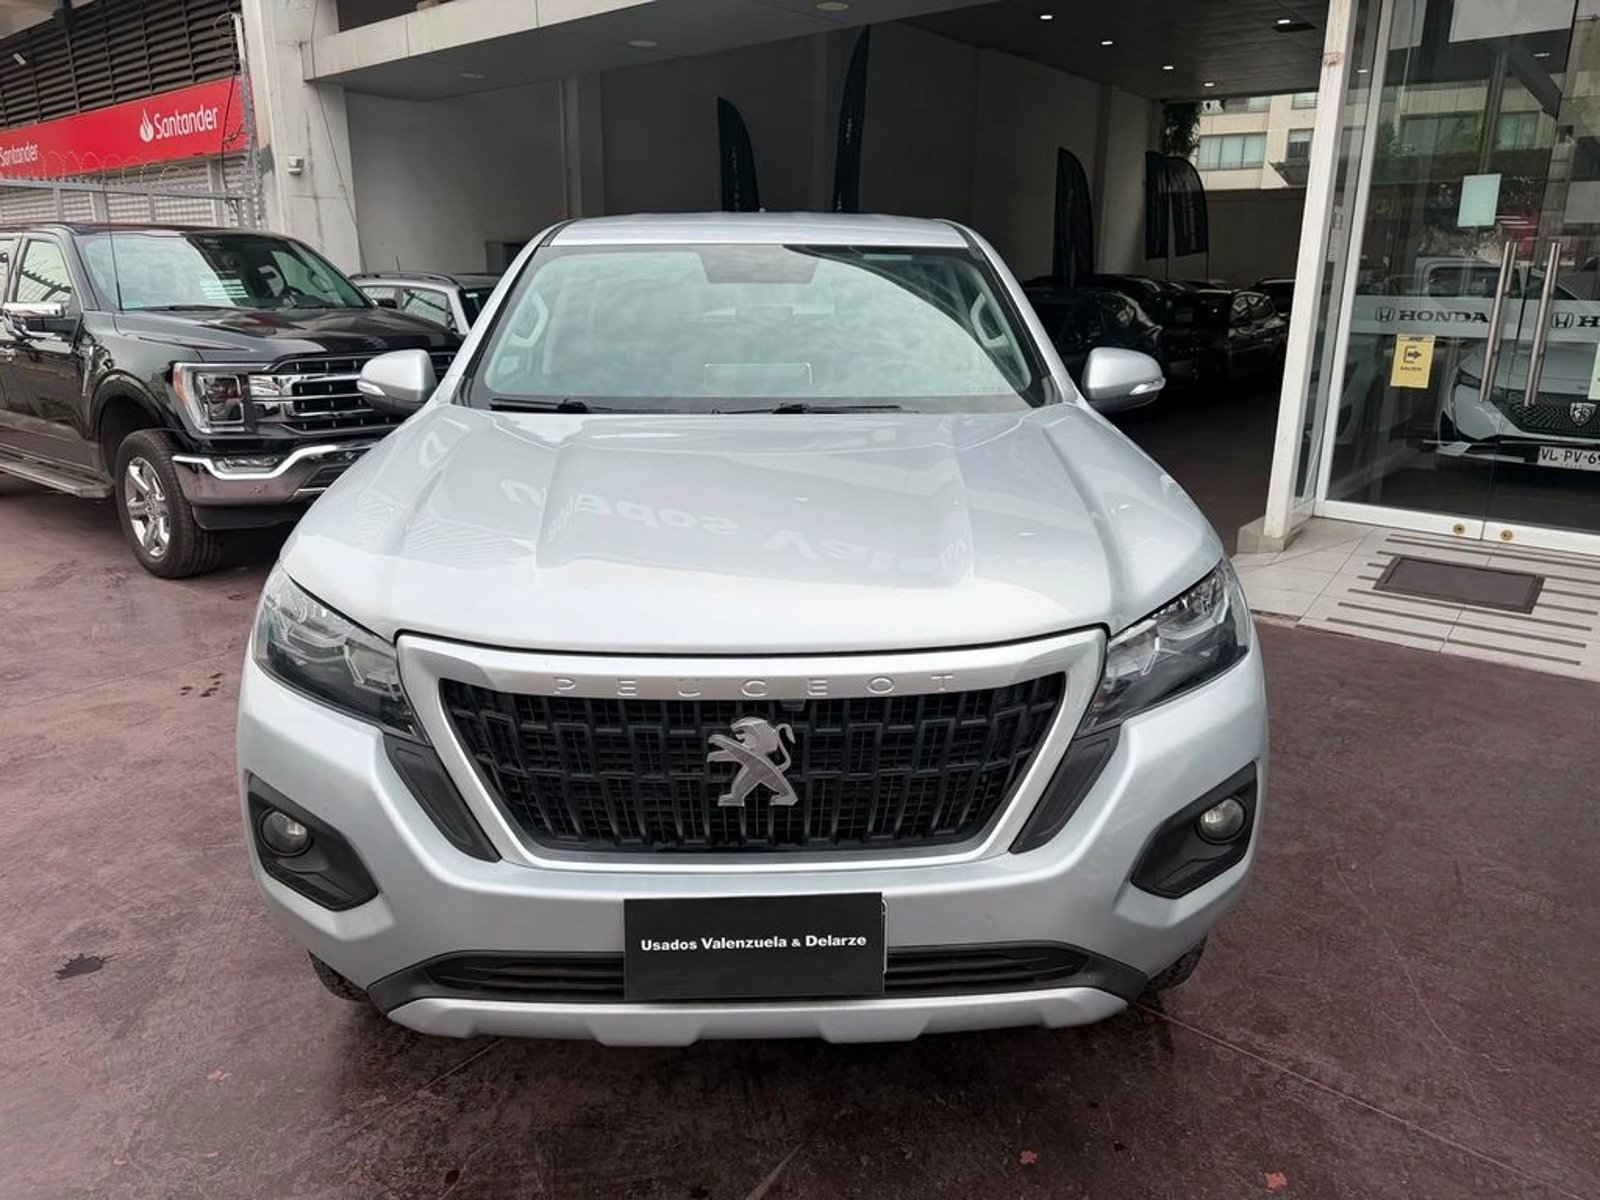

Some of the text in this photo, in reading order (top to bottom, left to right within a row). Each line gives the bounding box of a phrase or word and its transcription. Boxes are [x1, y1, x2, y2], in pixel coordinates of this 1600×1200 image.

[154, 104, 218, 140] Santander
[1399, 310, 1488, 322] HONDA
[553, 673, 955, 698] PEUGEOT
[641, 935, 867, 951] Usados Valenzuela & Delarze
